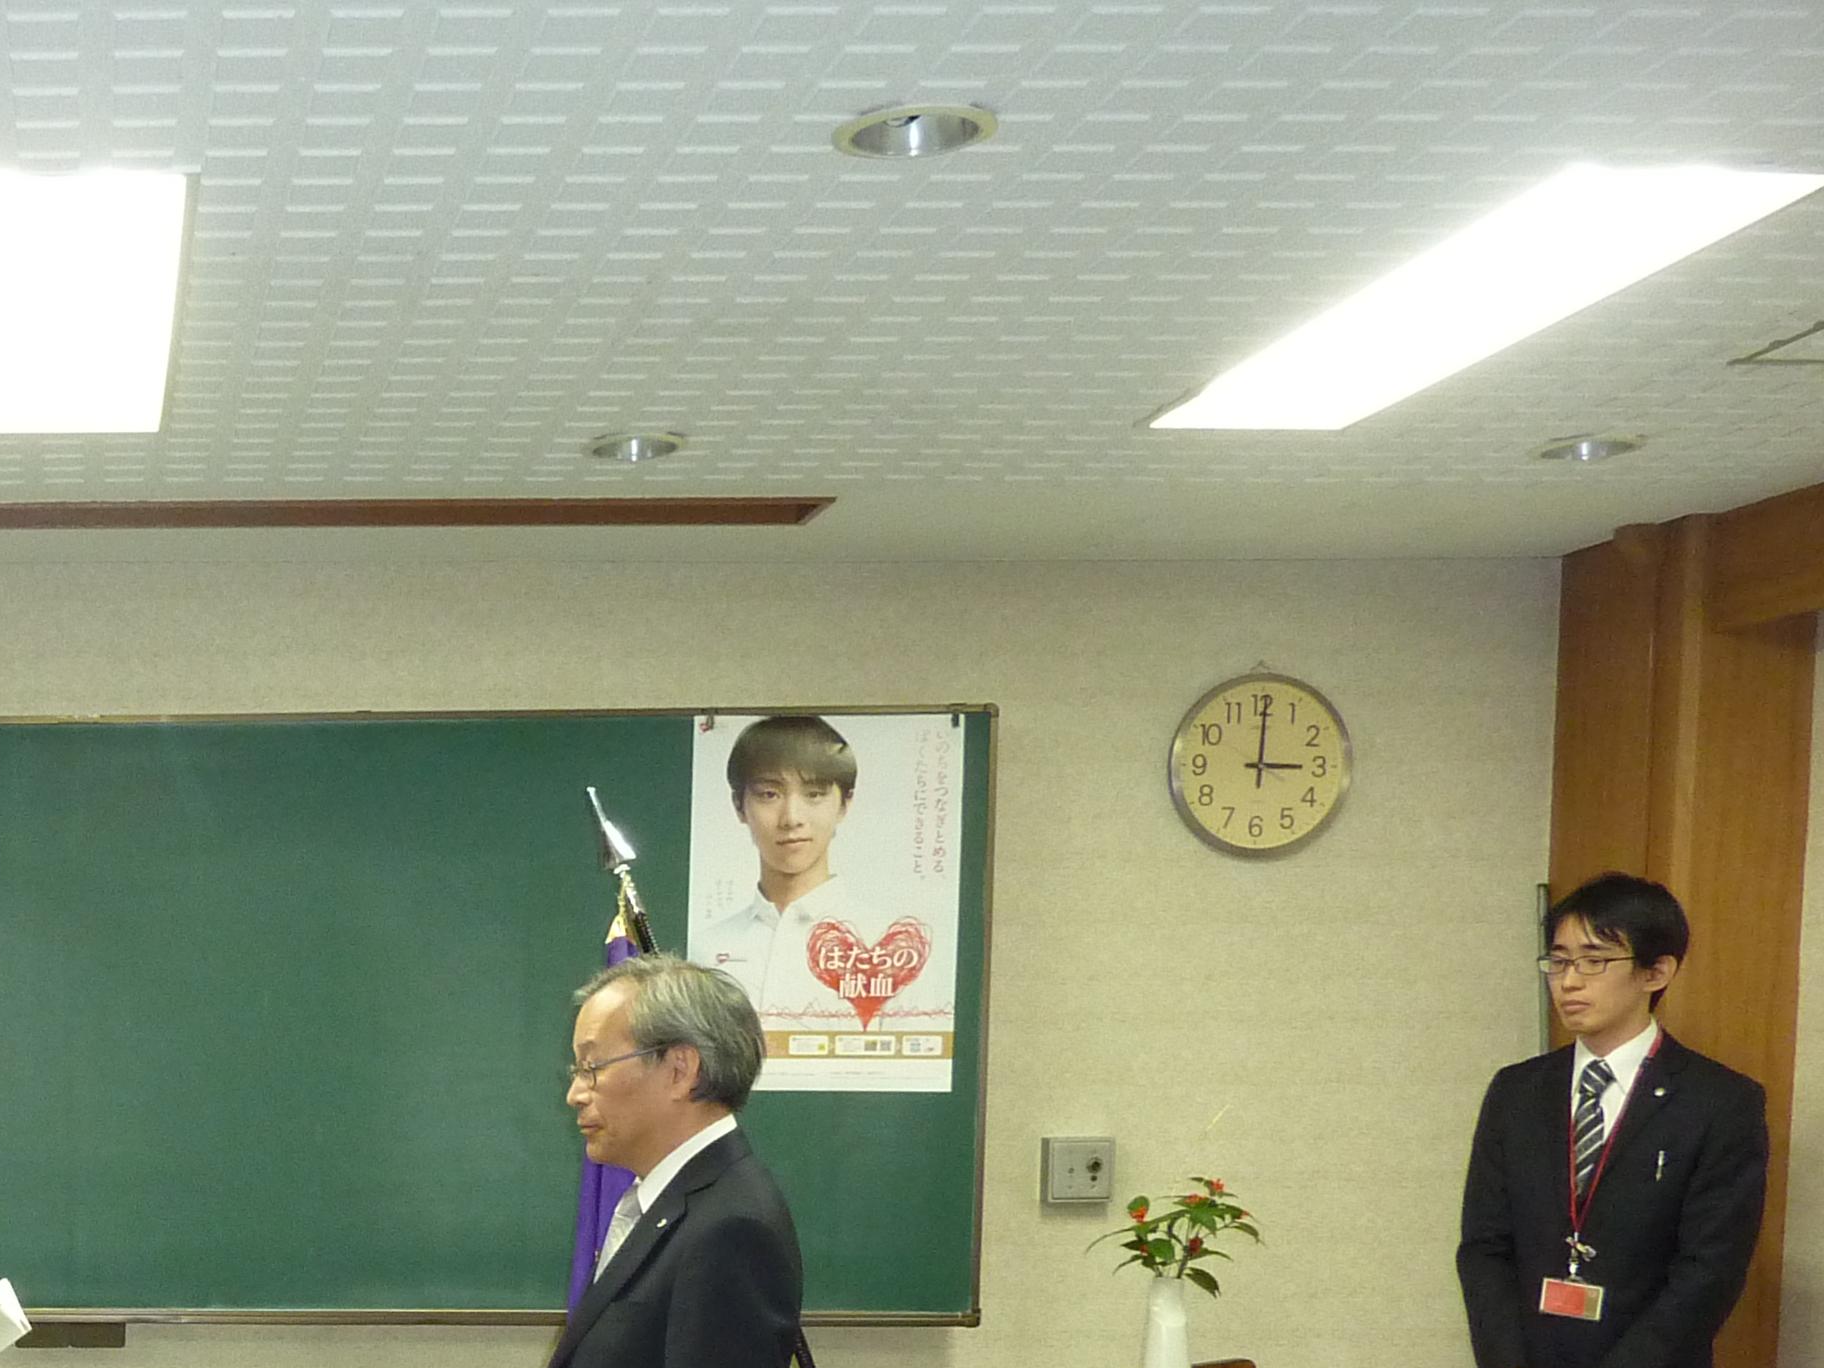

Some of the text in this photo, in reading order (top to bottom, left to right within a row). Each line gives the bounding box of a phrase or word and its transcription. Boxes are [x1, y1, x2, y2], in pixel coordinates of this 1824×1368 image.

[1225, 702, 1242, 724] 11
[1251, 694, 1274, 717] 12
[1289, 702, 1296, 725] 1
[1200, 723, 1223, 746] 10
[1305, 725, 1321, 747] 2
[1192, 754, 1207, 776] 9
[1311, 756, 1326, 778] 3
[1198, 784, 1214, 806] 8
[1301, 786, 1317, 807] 4
[1221, 806, 1235, 829] 7
[1248, 816, 1263, 838] 6
[1280, 807, 1294, 830] 5
[818, 945, 919, 971] はたちの
[838, 975, 896, 999] 献血
